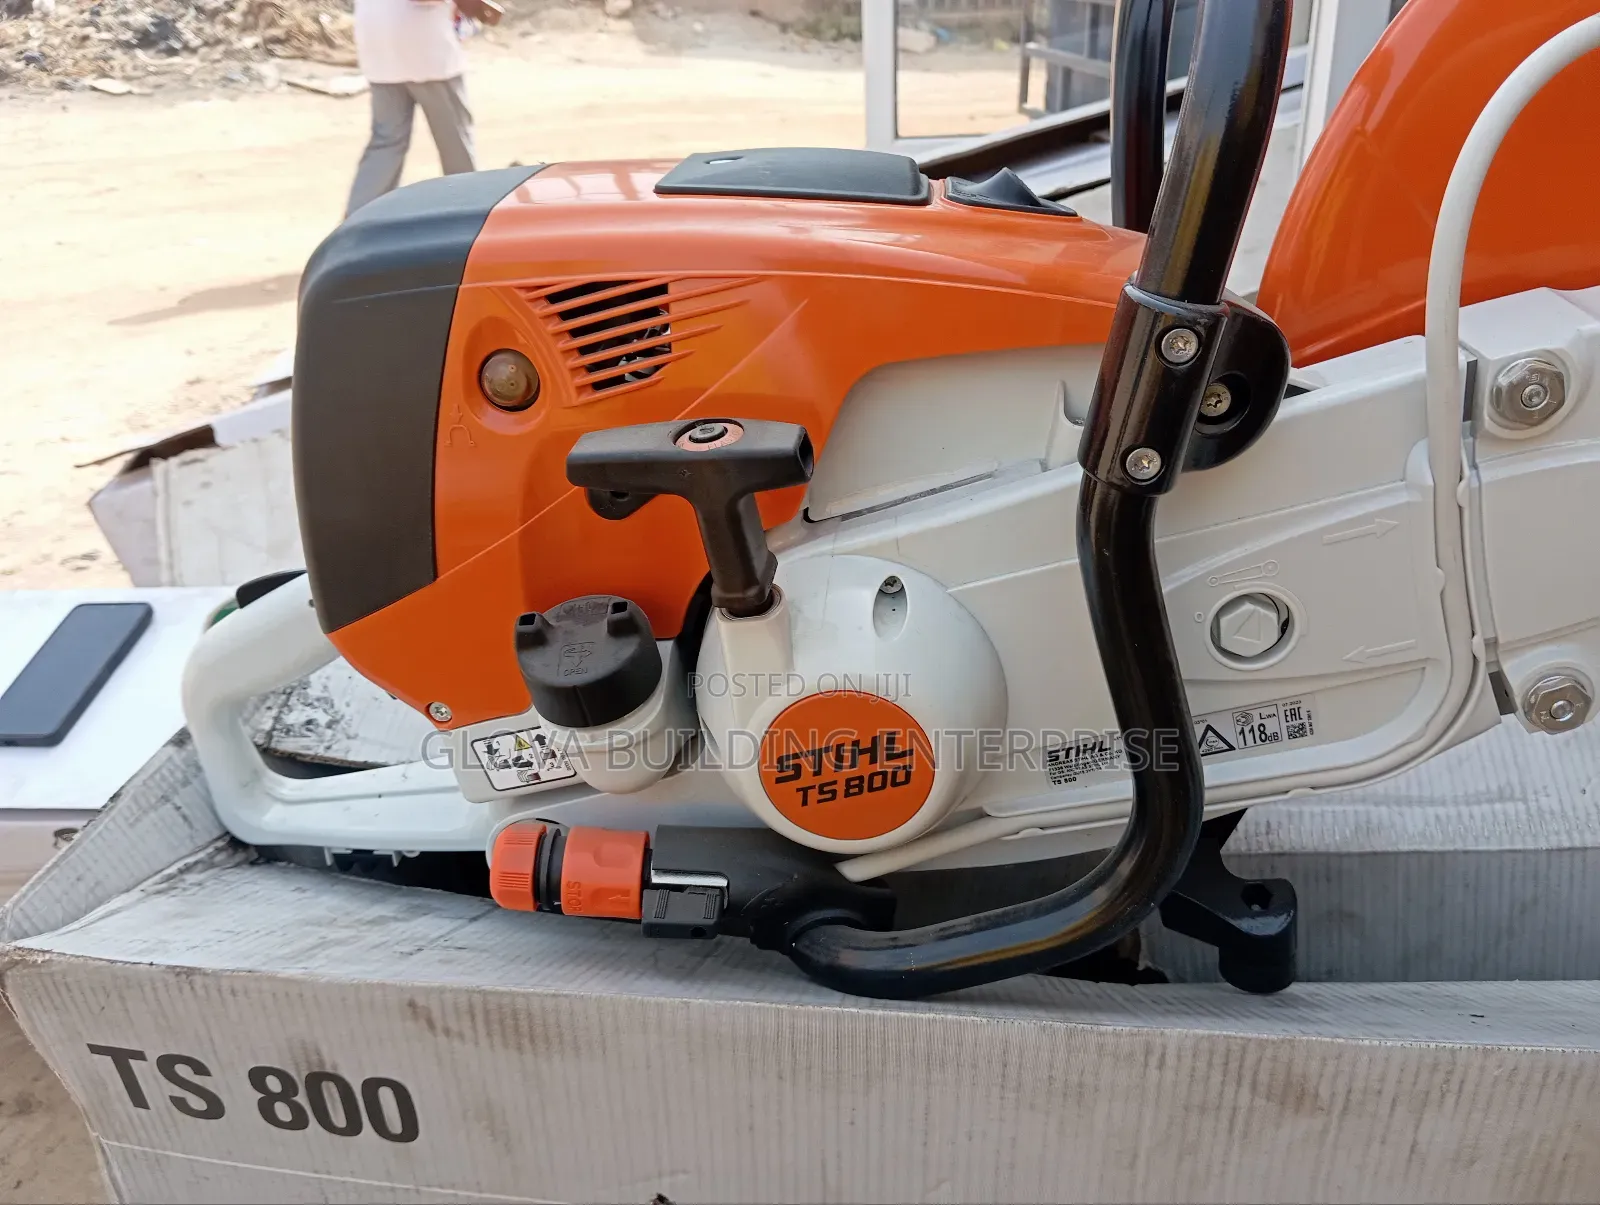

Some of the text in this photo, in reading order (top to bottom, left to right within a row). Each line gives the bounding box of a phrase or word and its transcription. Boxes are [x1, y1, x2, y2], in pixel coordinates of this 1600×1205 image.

[563, 666, 589, 678] OPEN
[775, 731, 914, 785] STIHL
[1047, 740, 1110, 763] STIHL
[565, 880, 584, 913] STOP
[86, 1042, 420, 1144] TS 800
